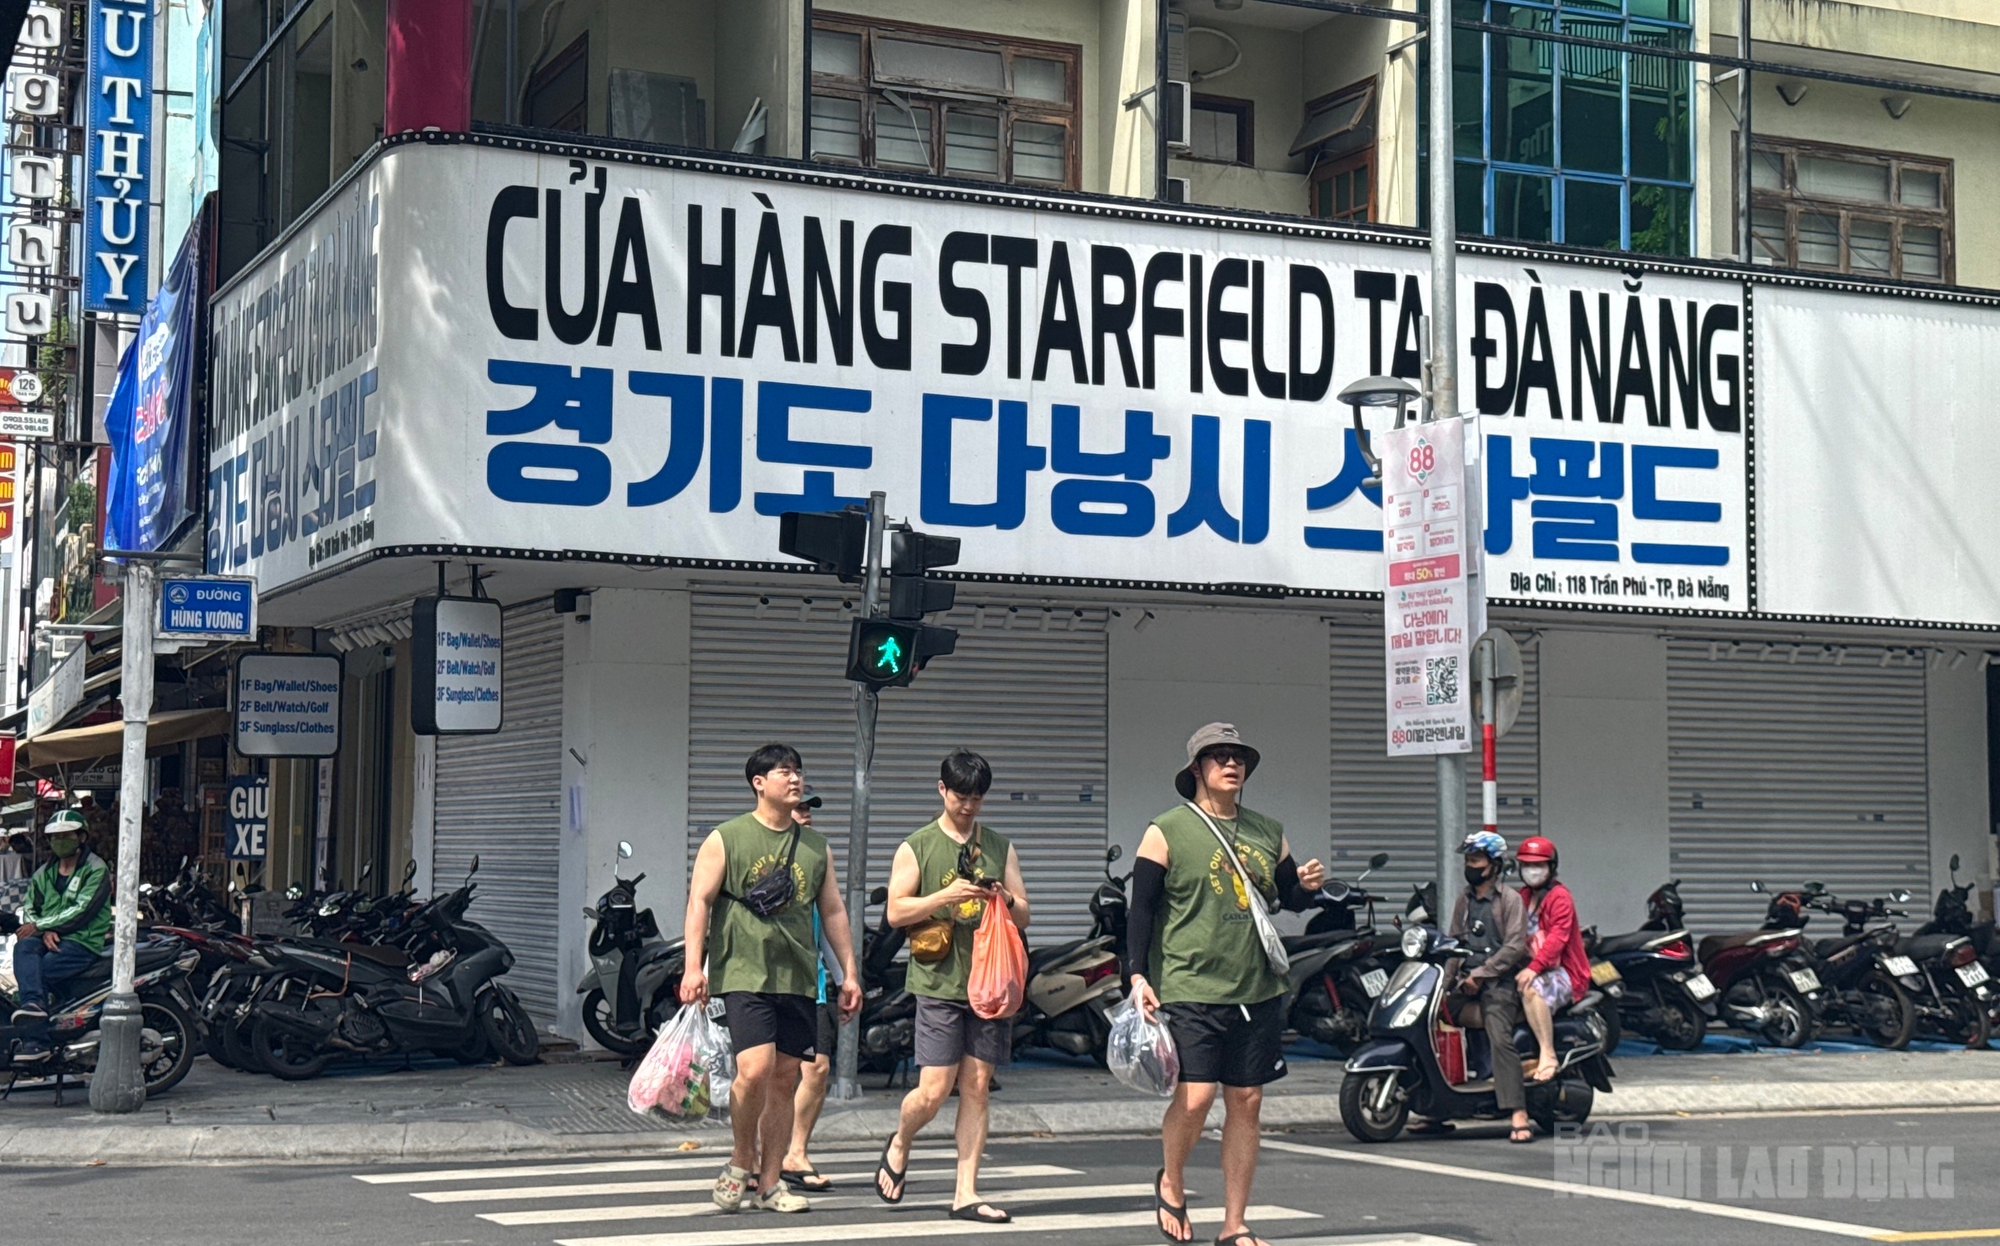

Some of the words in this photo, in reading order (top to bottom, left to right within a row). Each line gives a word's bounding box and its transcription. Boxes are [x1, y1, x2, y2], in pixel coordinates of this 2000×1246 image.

[95, 76, 144, 301] THỦY
[486, 159, 662, 352] CỬA
[687, 191, 911, 371] HÀNG
[939, 230, 1334, 402] STARFIELD
[1470, 268, 1564, 420] ĐÀ
[1570, 267, 1741, 433] NẴNG
[18, 378, 36, 391] 126
[486, 359, 873, 518] 경기도
[919, 393, 1272, 546] 다낭시
[1410, 444, 1434, 473] 88
[196, 586, 242, 602] ĐƯỜNG
[1510, 571, 1531, 596] Địa
[1566, 575, 1587, 595] 118
[1623, 575, 1647, 597] Phú
[1677, 576, 1694, 598] Đà
[1698, 575, 1730, 602] Nẵng
[171, 606, 202, 628] HÙNG
[205, 609, 243, 630] VƯƠNG
[1403, 609, 1448, 629] 다낭에서
[438, 632, 446, 646] 1F
[447, 632, 501, 650] Bag/Wallet/Shoes
[1391, 631, 1412, 649] 제일
[1414, 628, 1462, 647] 잘합니다!
[437, 660, 446, 675] 2F
[447, 660, 496, 676] Belt/Watch/Golf
[241, 680, 252, 691] 1F
[254, 680, 338, 694] Bag/Wallet/Shoes
[437, 687, 446, 702] 3F
[446, 687, 499, 705] Sunglass/Clothes
[240, 701, 252, 712] 2F
[254, 700, 329, 713] Belt/Watch/Golf
[240, 721, 252, 733] 3F
[254, 721, 335, 735] Sunglass/Clothes
[232, 824, 266, 856] XE
[1209, 848, 1224, 870] OUT
[941, 868, 956, 886] OUT
[1209, 873, 1224, 895] GET
